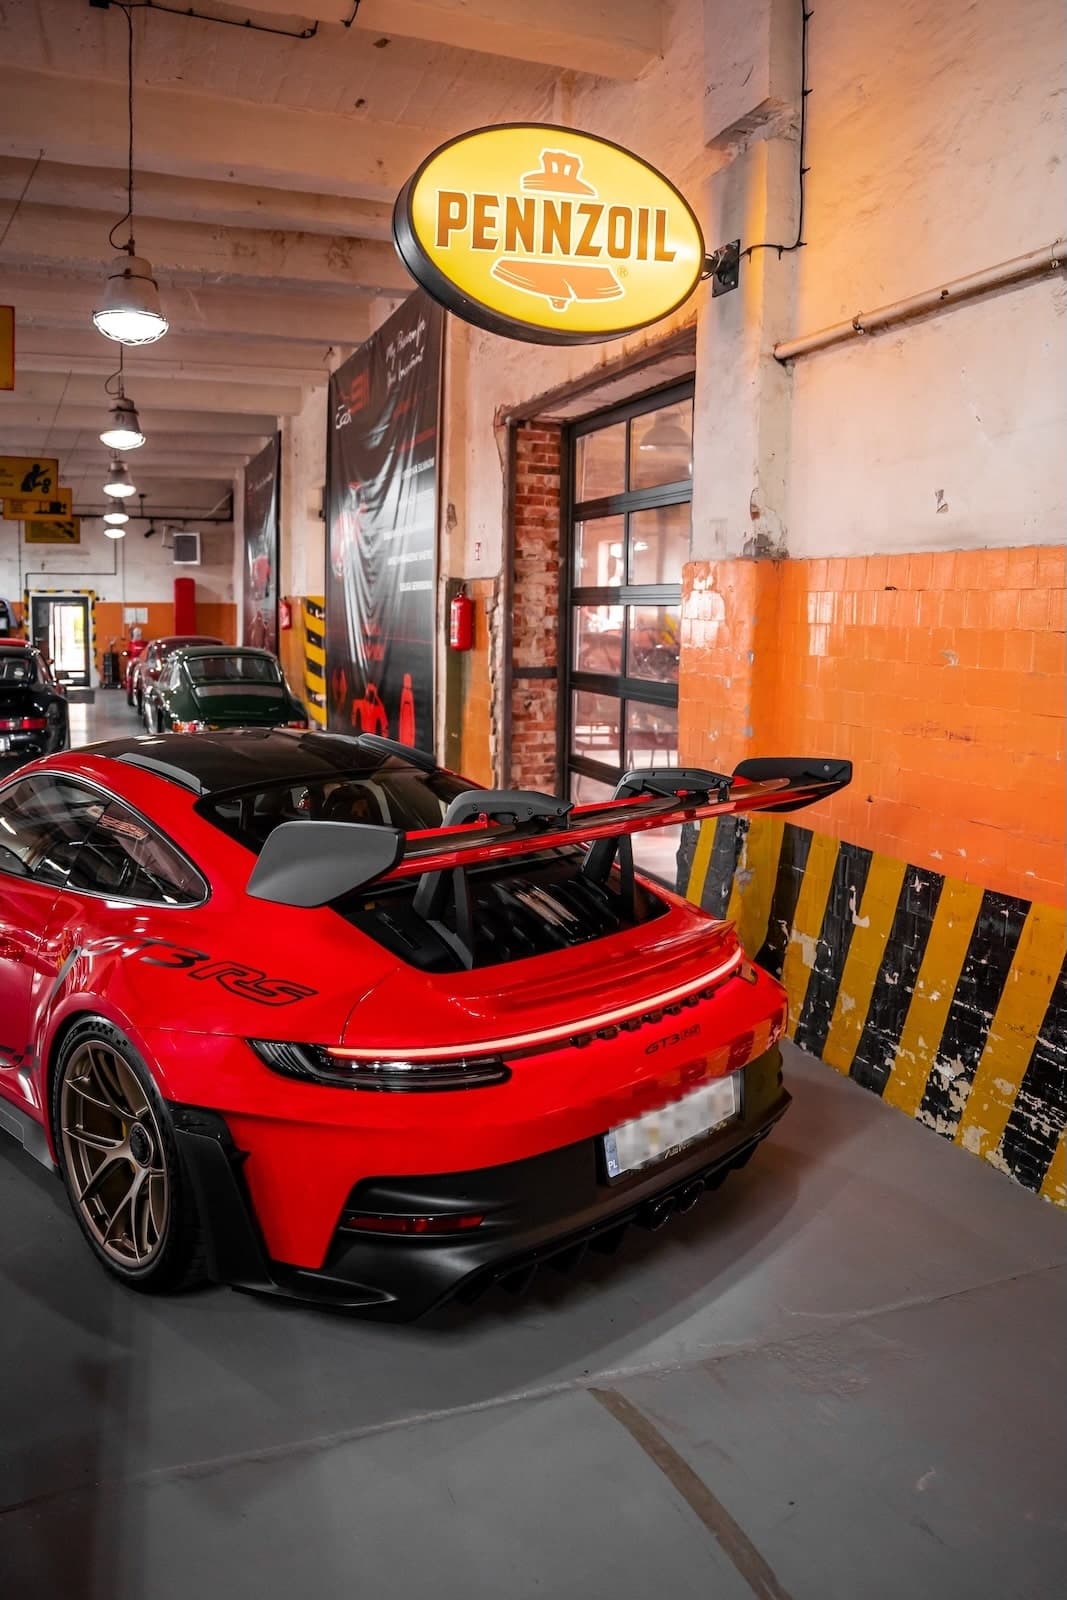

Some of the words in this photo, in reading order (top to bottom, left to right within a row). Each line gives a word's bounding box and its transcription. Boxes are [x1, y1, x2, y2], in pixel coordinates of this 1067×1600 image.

[436, 190, 677, 262] PENNZOIL
[188, 960, 318, 1006] RS
[645, 1032, 681, 1055] GT3
[607, 1159, 618, 1171] PL
